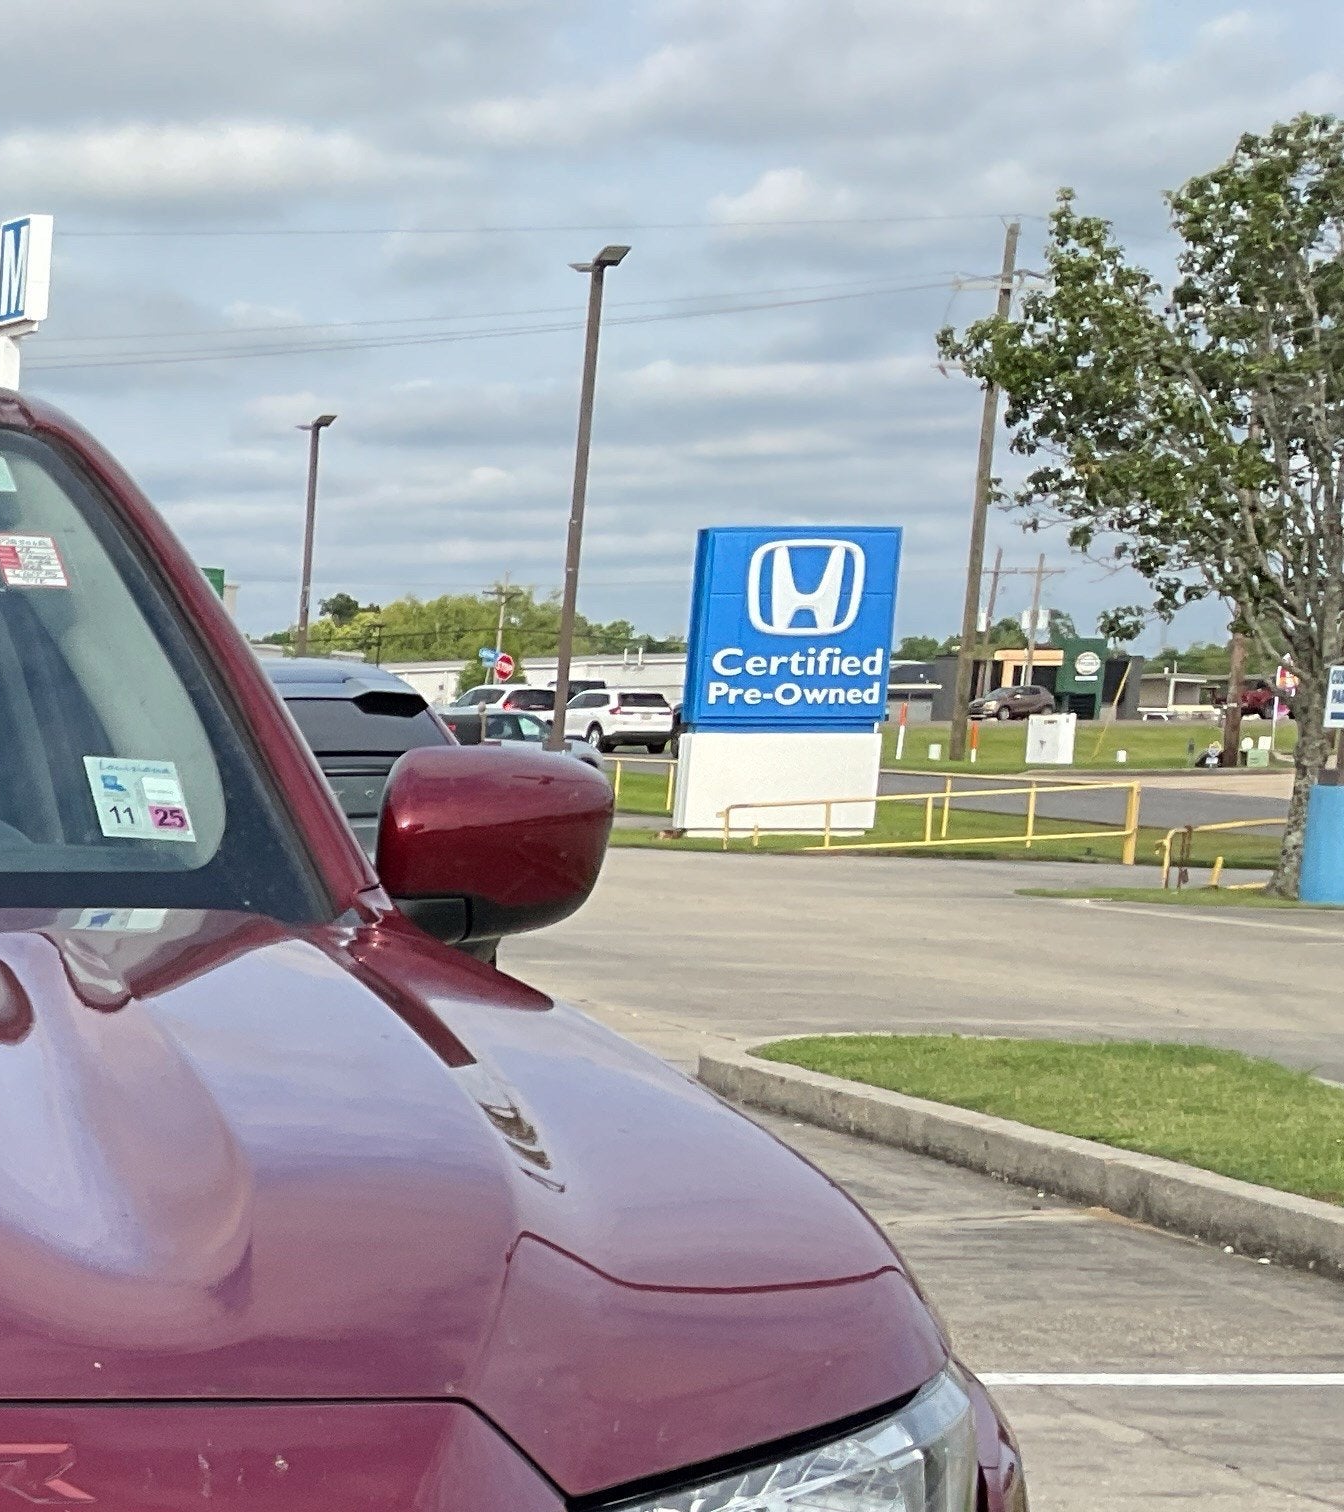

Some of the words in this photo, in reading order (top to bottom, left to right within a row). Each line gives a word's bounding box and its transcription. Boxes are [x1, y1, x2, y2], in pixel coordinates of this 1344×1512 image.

[712, 647, 884, 677] Certified
[707, 681, 881, 706] Pre-Owned
[109, 805, 135, 824] 11
[154, 808, 186, 828] 25
